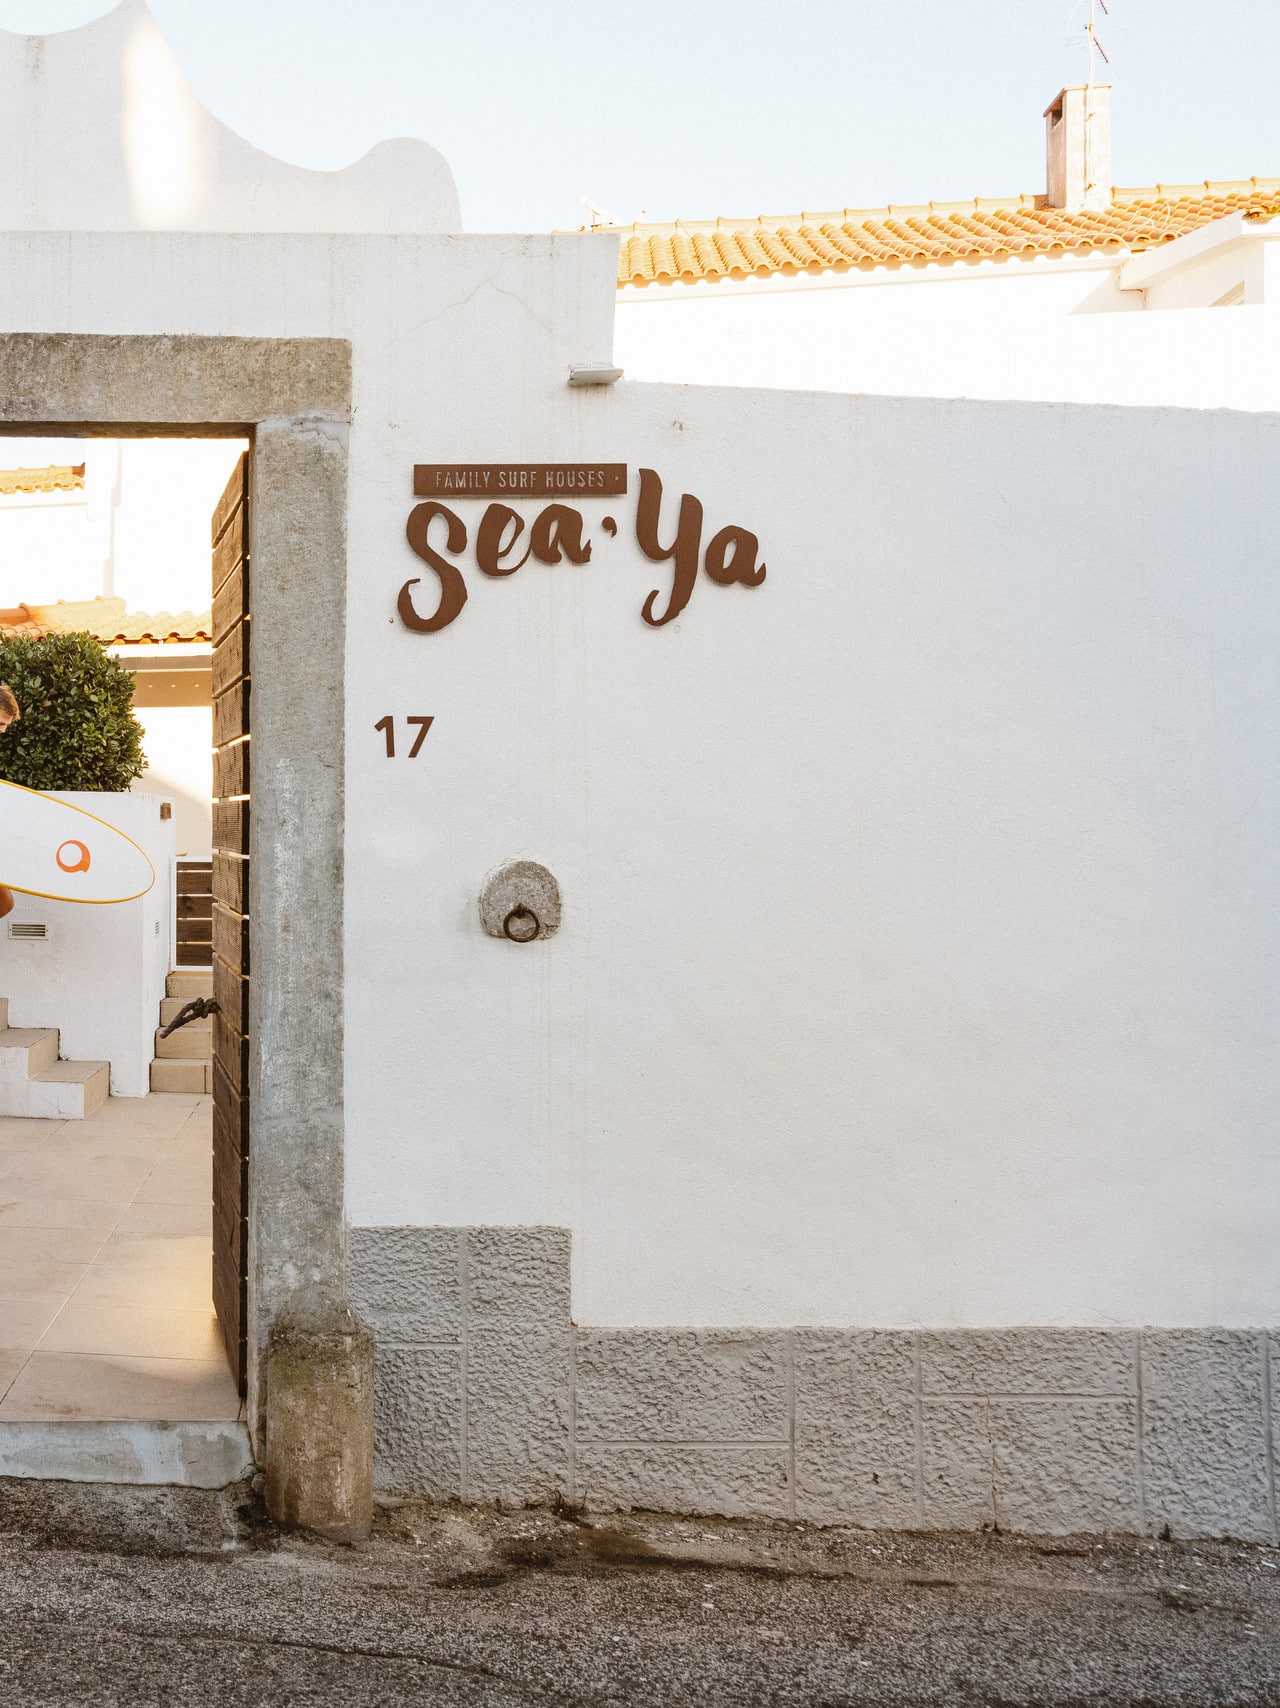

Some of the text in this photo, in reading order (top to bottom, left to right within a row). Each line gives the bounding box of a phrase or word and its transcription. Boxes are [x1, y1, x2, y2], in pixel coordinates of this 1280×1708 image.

[436, 470, 605, 488] FAMILY SURF HOUSES
[374, 715, 435, 758] 17
